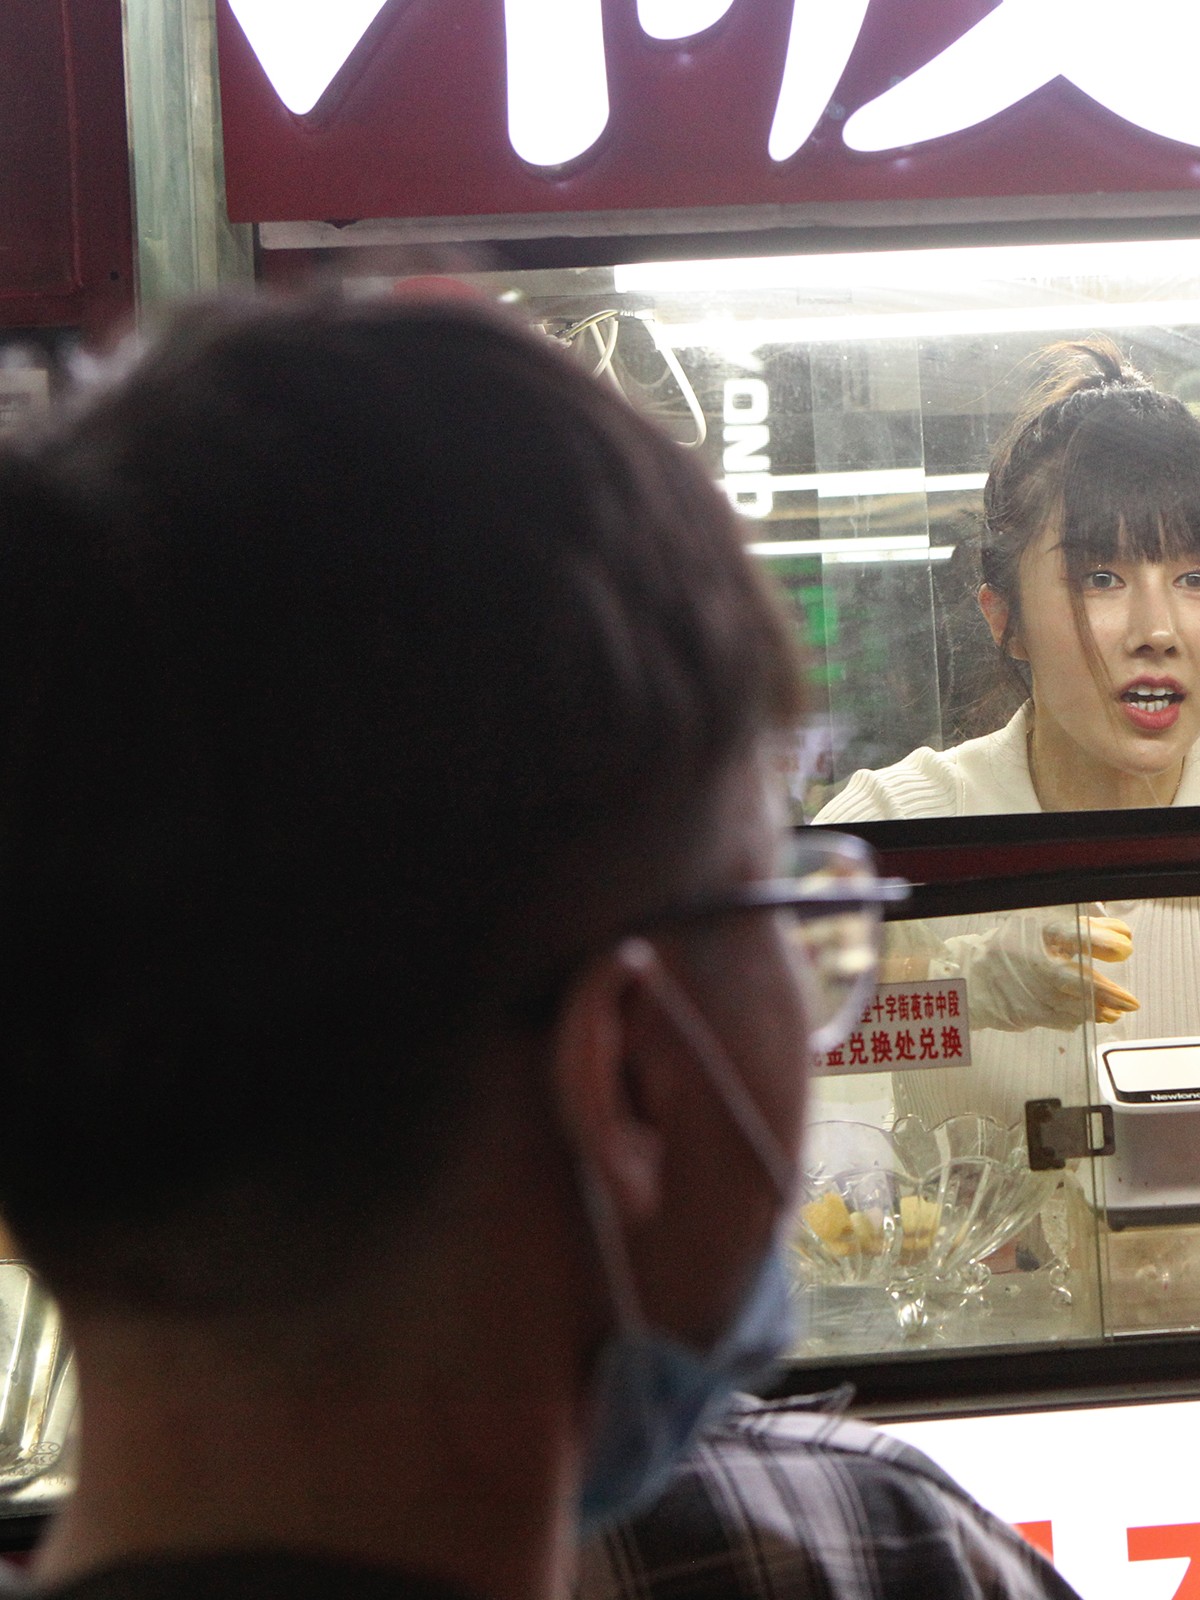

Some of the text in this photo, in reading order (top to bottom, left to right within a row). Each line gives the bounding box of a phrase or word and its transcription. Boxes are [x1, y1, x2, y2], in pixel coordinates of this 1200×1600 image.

[813, 1026, 963, 1067] 金兑换处兑换
